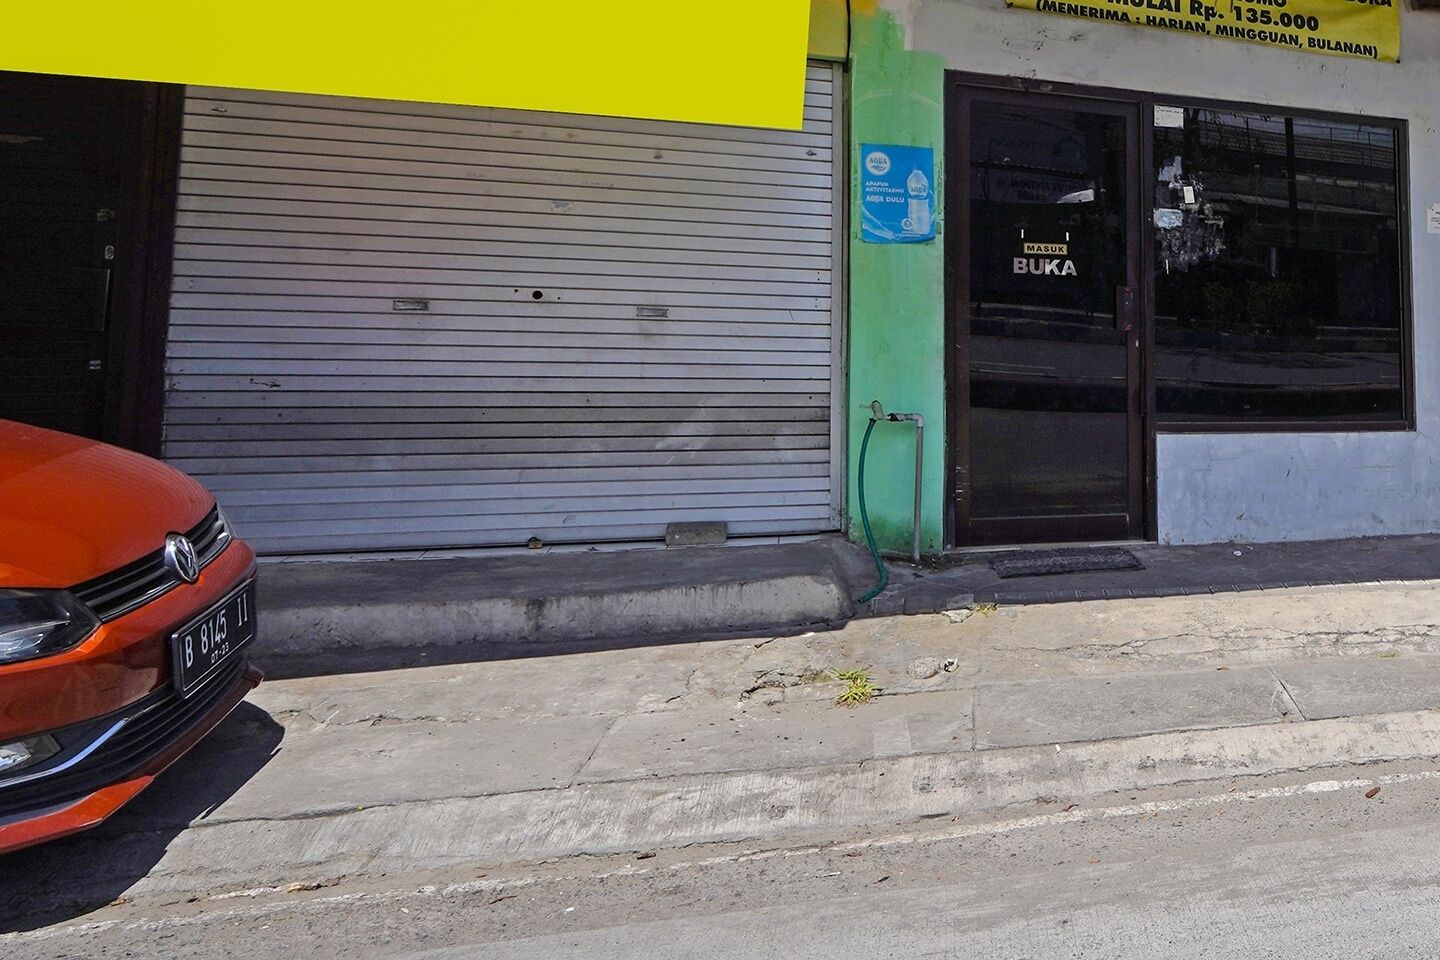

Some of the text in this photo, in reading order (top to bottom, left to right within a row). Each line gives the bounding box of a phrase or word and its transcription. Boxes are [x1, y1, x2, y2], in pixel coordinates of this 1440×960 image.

[1189, 0, 1224, 22] Rp.
[1233, 5, 1319, 32] 135.000
[1146, 15, 1211, 35] HARIAN,
[1215, 24, 1304, 49] MINGGUAN,
[1307, 36, 1378, 59] BULANAN)
[1027, 245, 1065, 253] MASUK
[1013, 257, 1078, 276] BUKA
[185, 635, 194, 669] B
[200, 608, 227, 655] 8145
